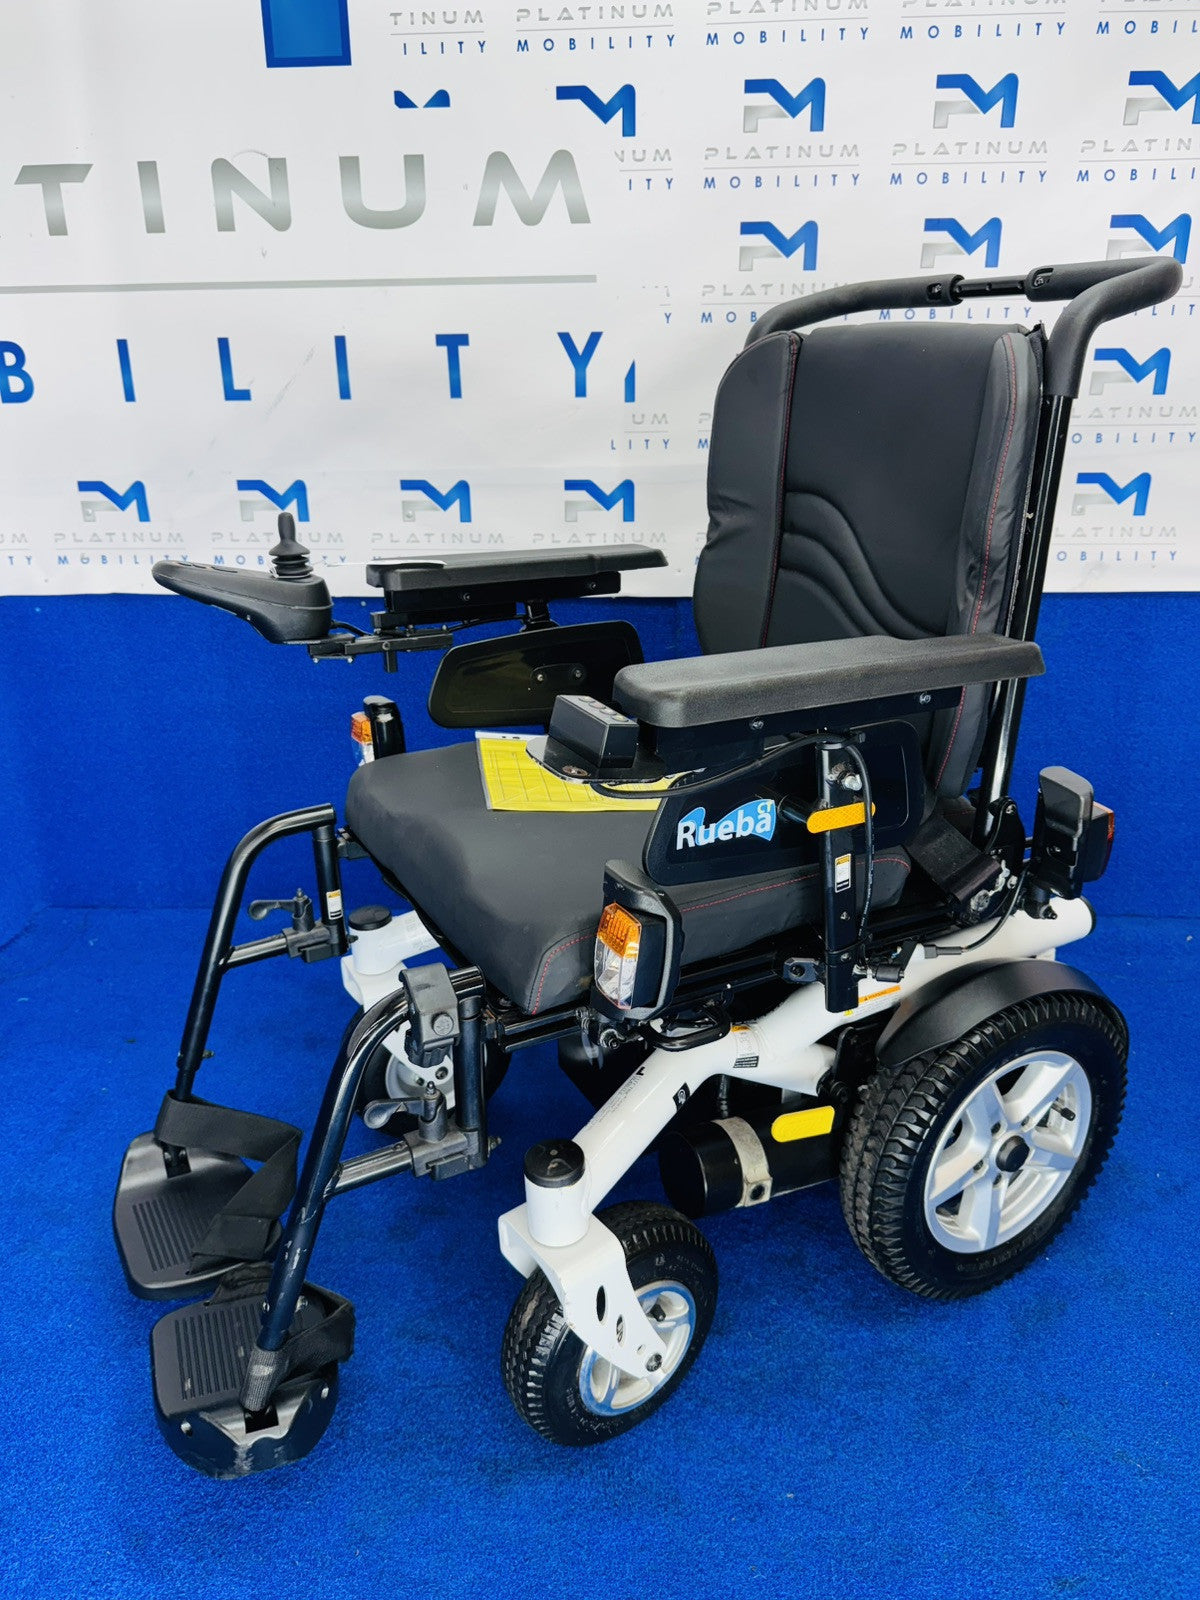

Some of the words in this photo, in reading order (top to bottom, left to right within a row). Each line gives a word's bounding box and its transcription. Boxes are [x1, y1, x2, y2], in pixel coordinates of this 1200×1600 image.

[516, 5, 674, 22] PLATINUM
[706, 27, 868, 45] MOBILITY
[900, 22, 1065, 39] MOBILITY
[517, 34, 675, 52] MOBILITY
[705, 144, 858, 160] PLATINUM
[893, 141, 1047, 156] PLATINUM
[703, 174, 860, 189] MOBILITY
[890, 170, 1047, 185] MOBILITY
[1072, 406, 1197, 418] LATINUM
[1072, 432, 1196, 443] OBILITY
[54, 533, 184, 543] PLATINUM
[211, 532, 344, 543] PLATUM
[372, 533, 504, 543] PLATINUM
[533, 532, 667, 543] PLATINUM
[1055, 526, 1176, 538] LATINUM
[1057, 551, 1177, 561] OBILITY
[676, 810, 772, 851] Rueba
